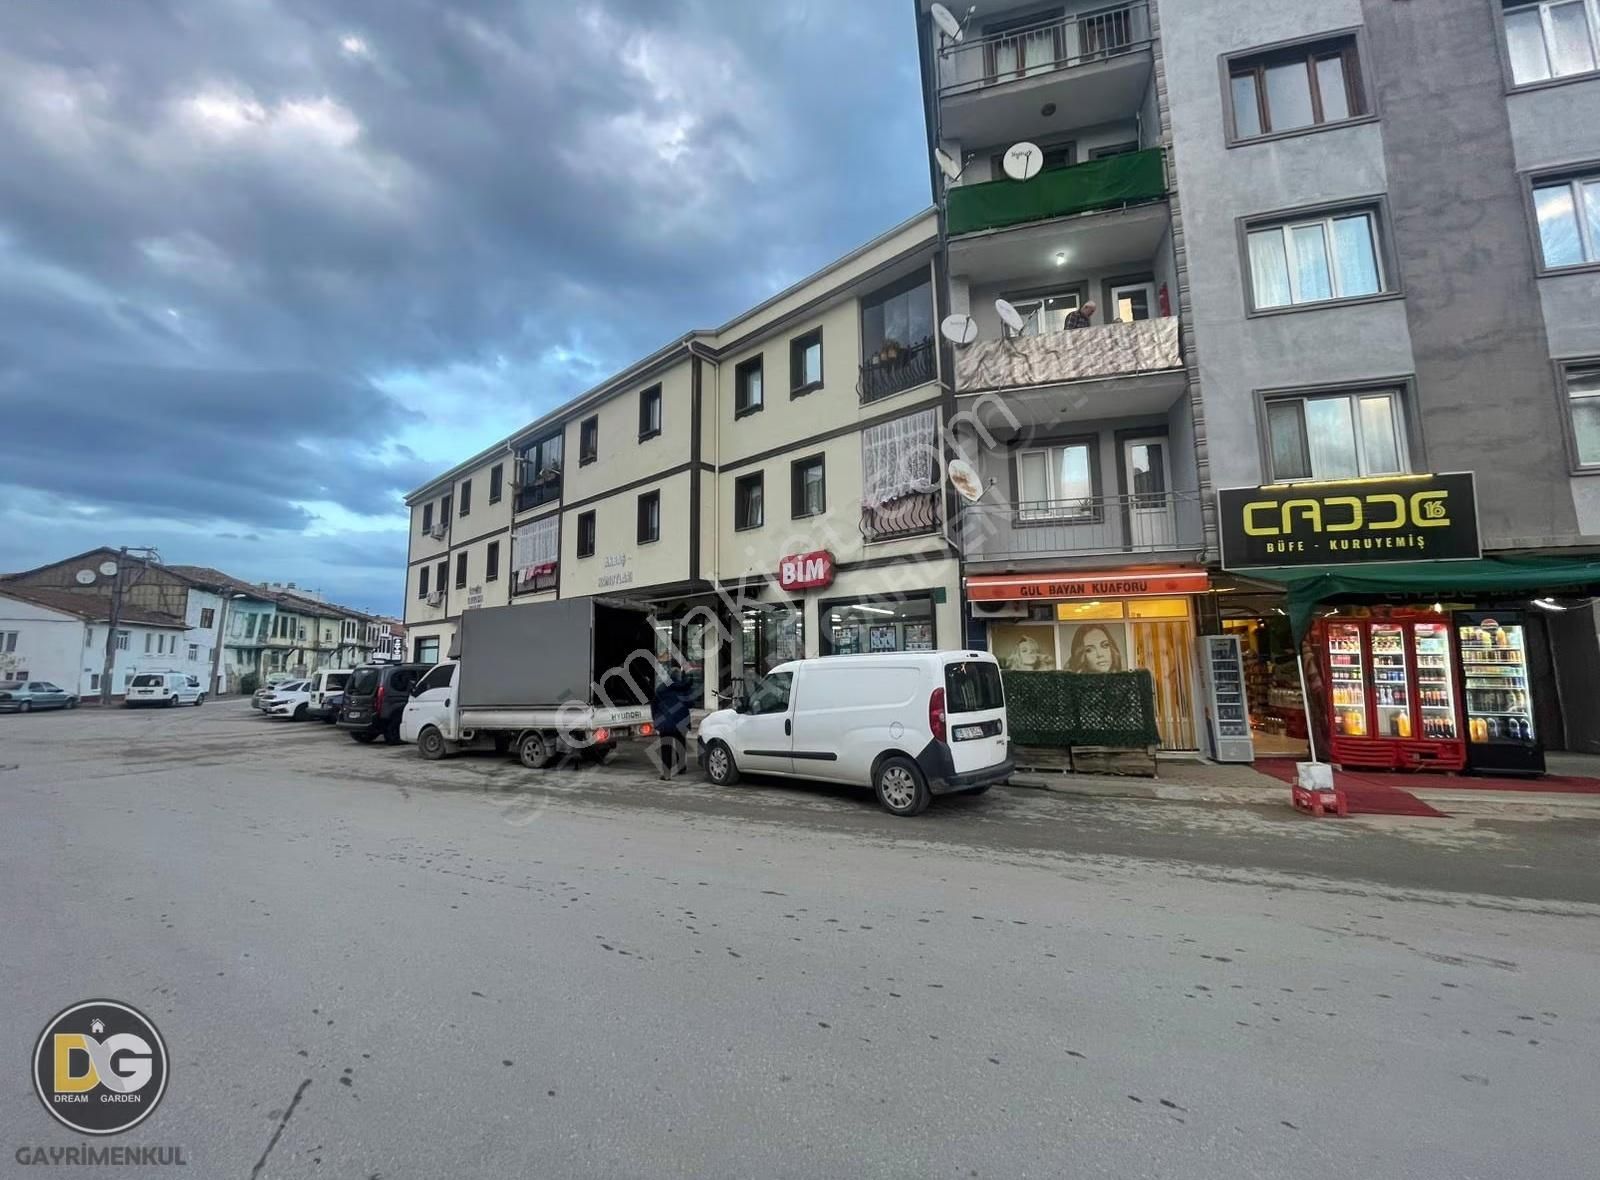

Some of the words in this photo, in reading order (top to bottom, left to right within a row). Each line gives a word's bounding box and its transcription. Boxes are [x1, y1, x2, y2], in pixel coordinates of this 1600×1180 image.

[1424, 501, 1446, 518] 16
[1266, 540, 1305, 553] BÜFE
[1329, 535, 1425, 550] KURUYEMİŞ
[781, 555, 825, 585] BİM
[1048, 583, 1085, 595] BAYAN
